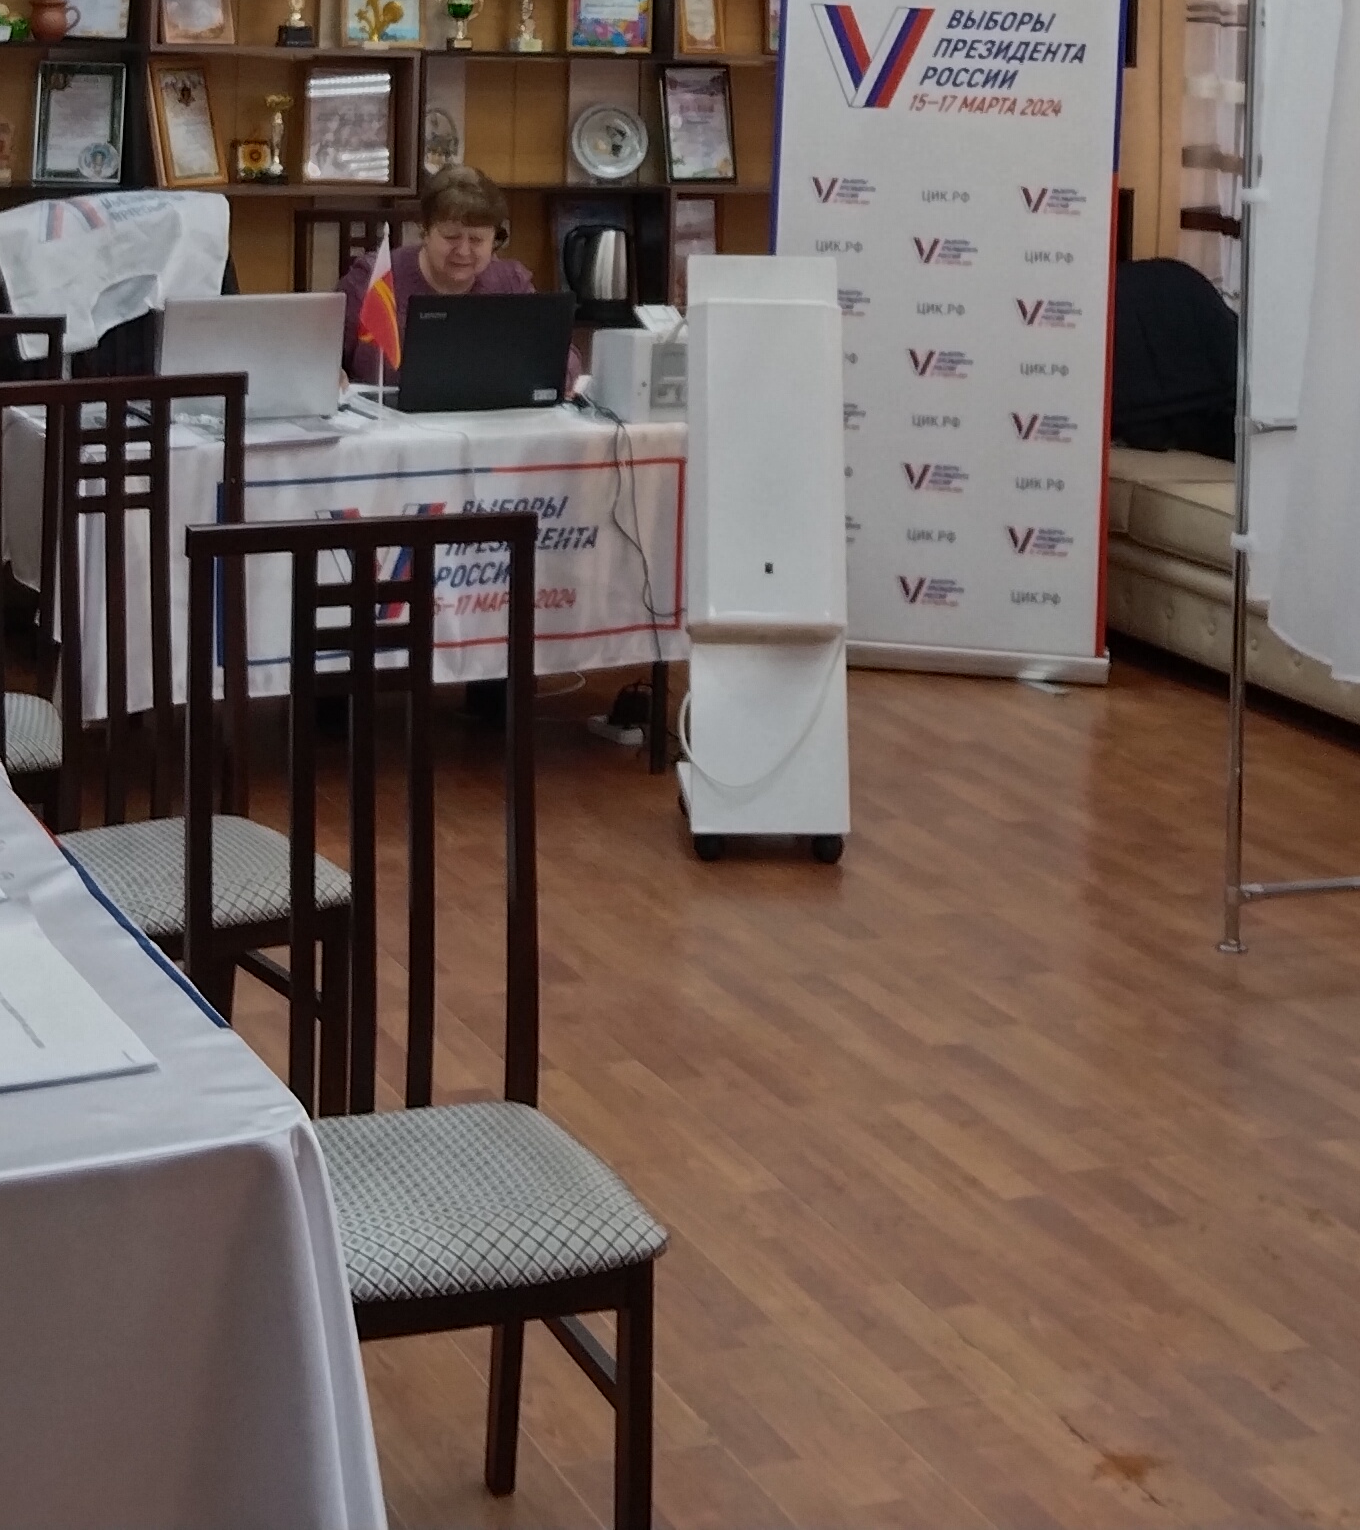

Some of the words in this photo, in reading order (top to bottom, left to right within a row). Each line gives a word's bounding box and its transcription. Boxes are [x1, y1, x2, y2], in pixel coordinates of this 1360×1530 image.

[946, 9, 1056, 33] ВЫБОРЫ
[932, 37, 1087, 64] ПРЕЗИДЕНТА
[919, 65, 1019, 89] РОССИИ
[957, 95, 1017, 114] МАРТА
[1019, 97, 1063, 117] 2024
[435, 562, 511, 588] РОССИ
[472, 591, 510, 614] МАР
